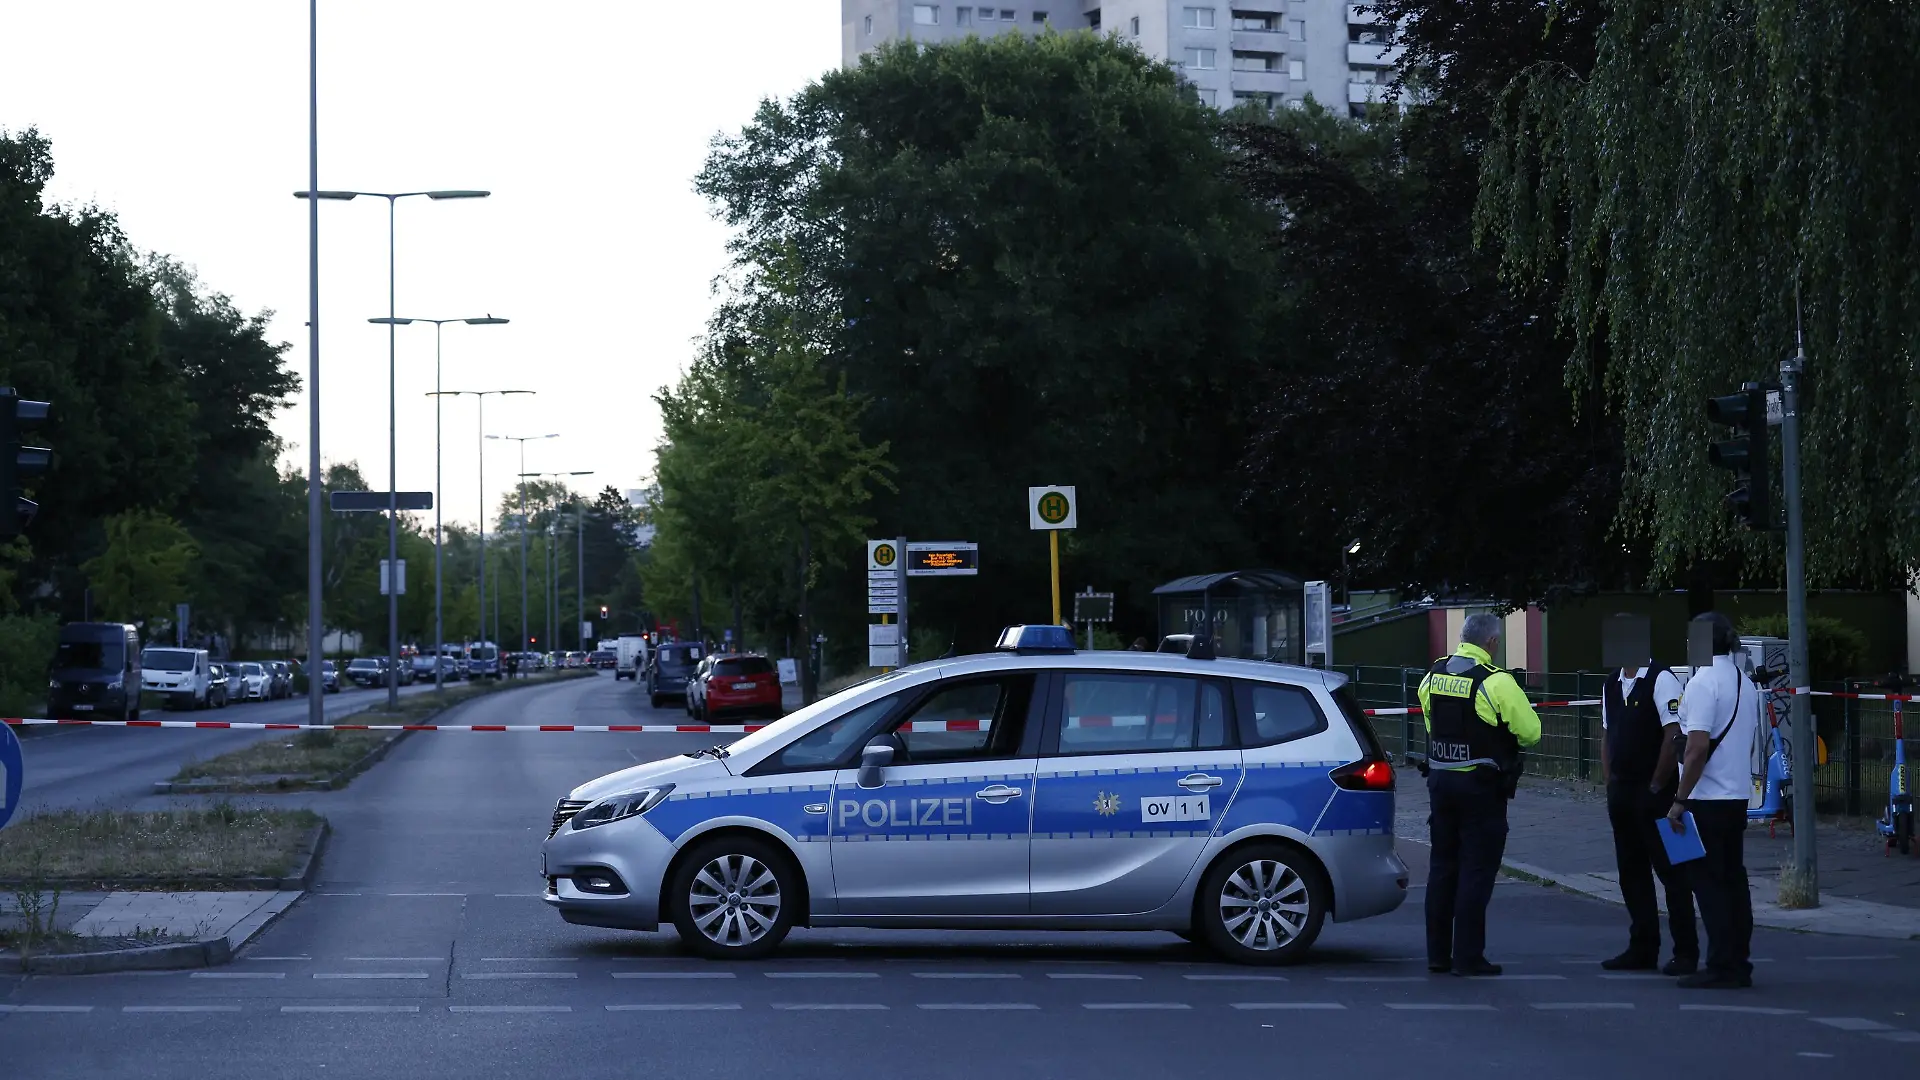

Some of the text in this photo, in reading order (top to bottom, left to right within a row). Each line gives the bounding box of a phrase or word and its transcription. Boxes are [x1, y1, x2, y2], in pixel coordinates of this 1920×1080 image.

[1046, 500, 1062, 517] H
[1184, 609, 1229, 623] POO
[1431, 676, 1471, 695] POLIZEI
[1432, 740, 1470, 761] POLIZEI
[839, 798, 973, 828] POLIZEI
[1147, 802, 1170, 816] OV
